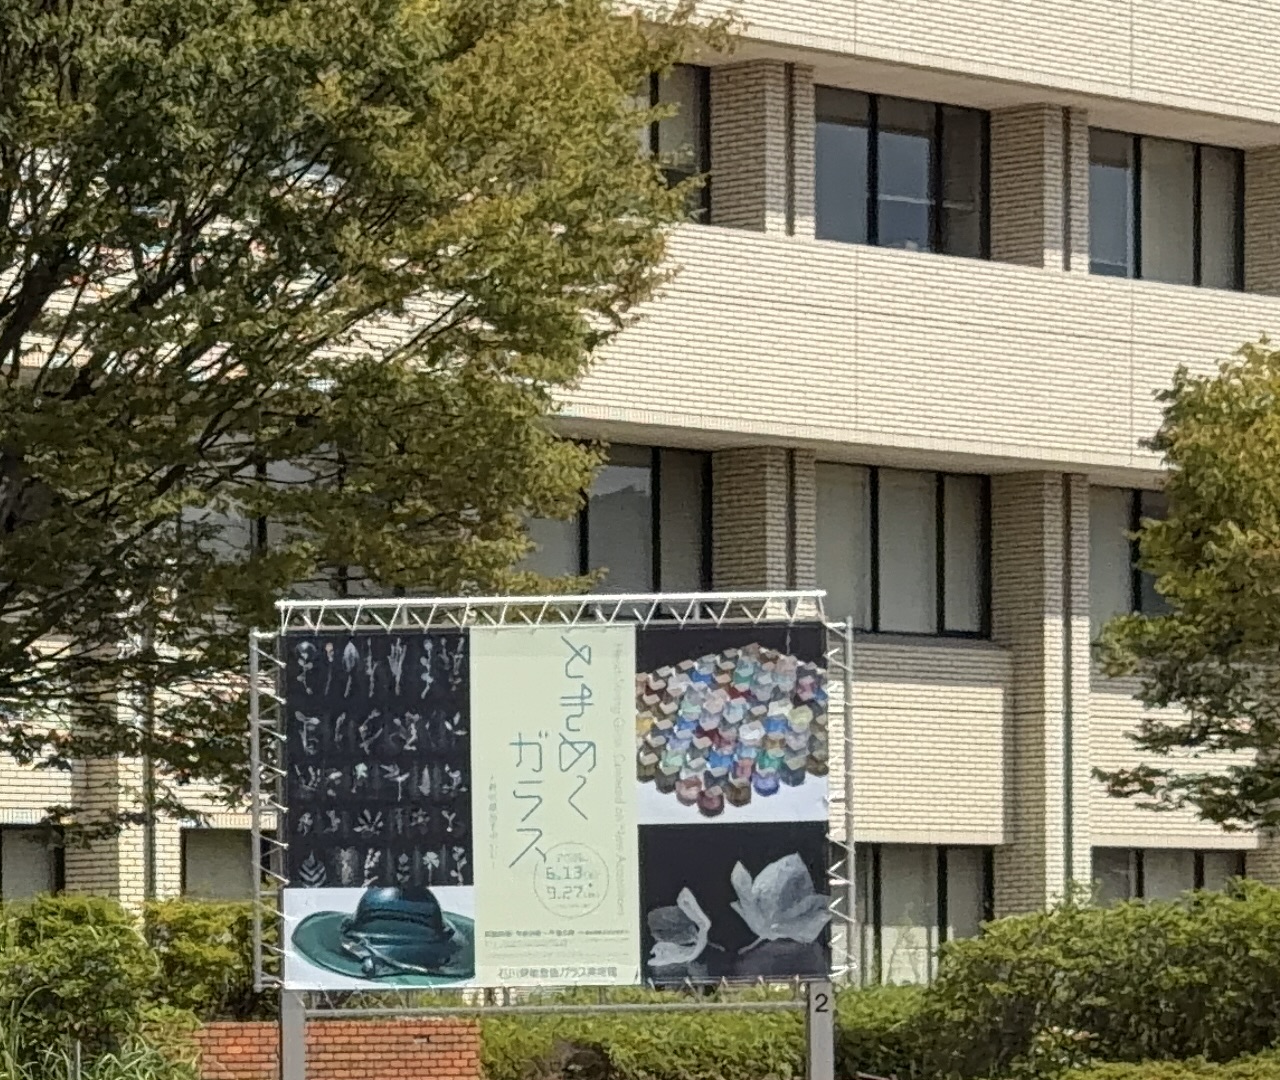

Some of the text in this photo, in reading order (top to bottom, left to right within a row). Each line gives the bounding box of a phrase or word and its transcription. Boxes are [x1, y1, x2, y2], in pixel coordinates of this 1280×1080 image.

[558, 635, 597, 820] ときめく
[508, 730, 548, 868] ガラス
[815, 993, 829, 1013] 2
